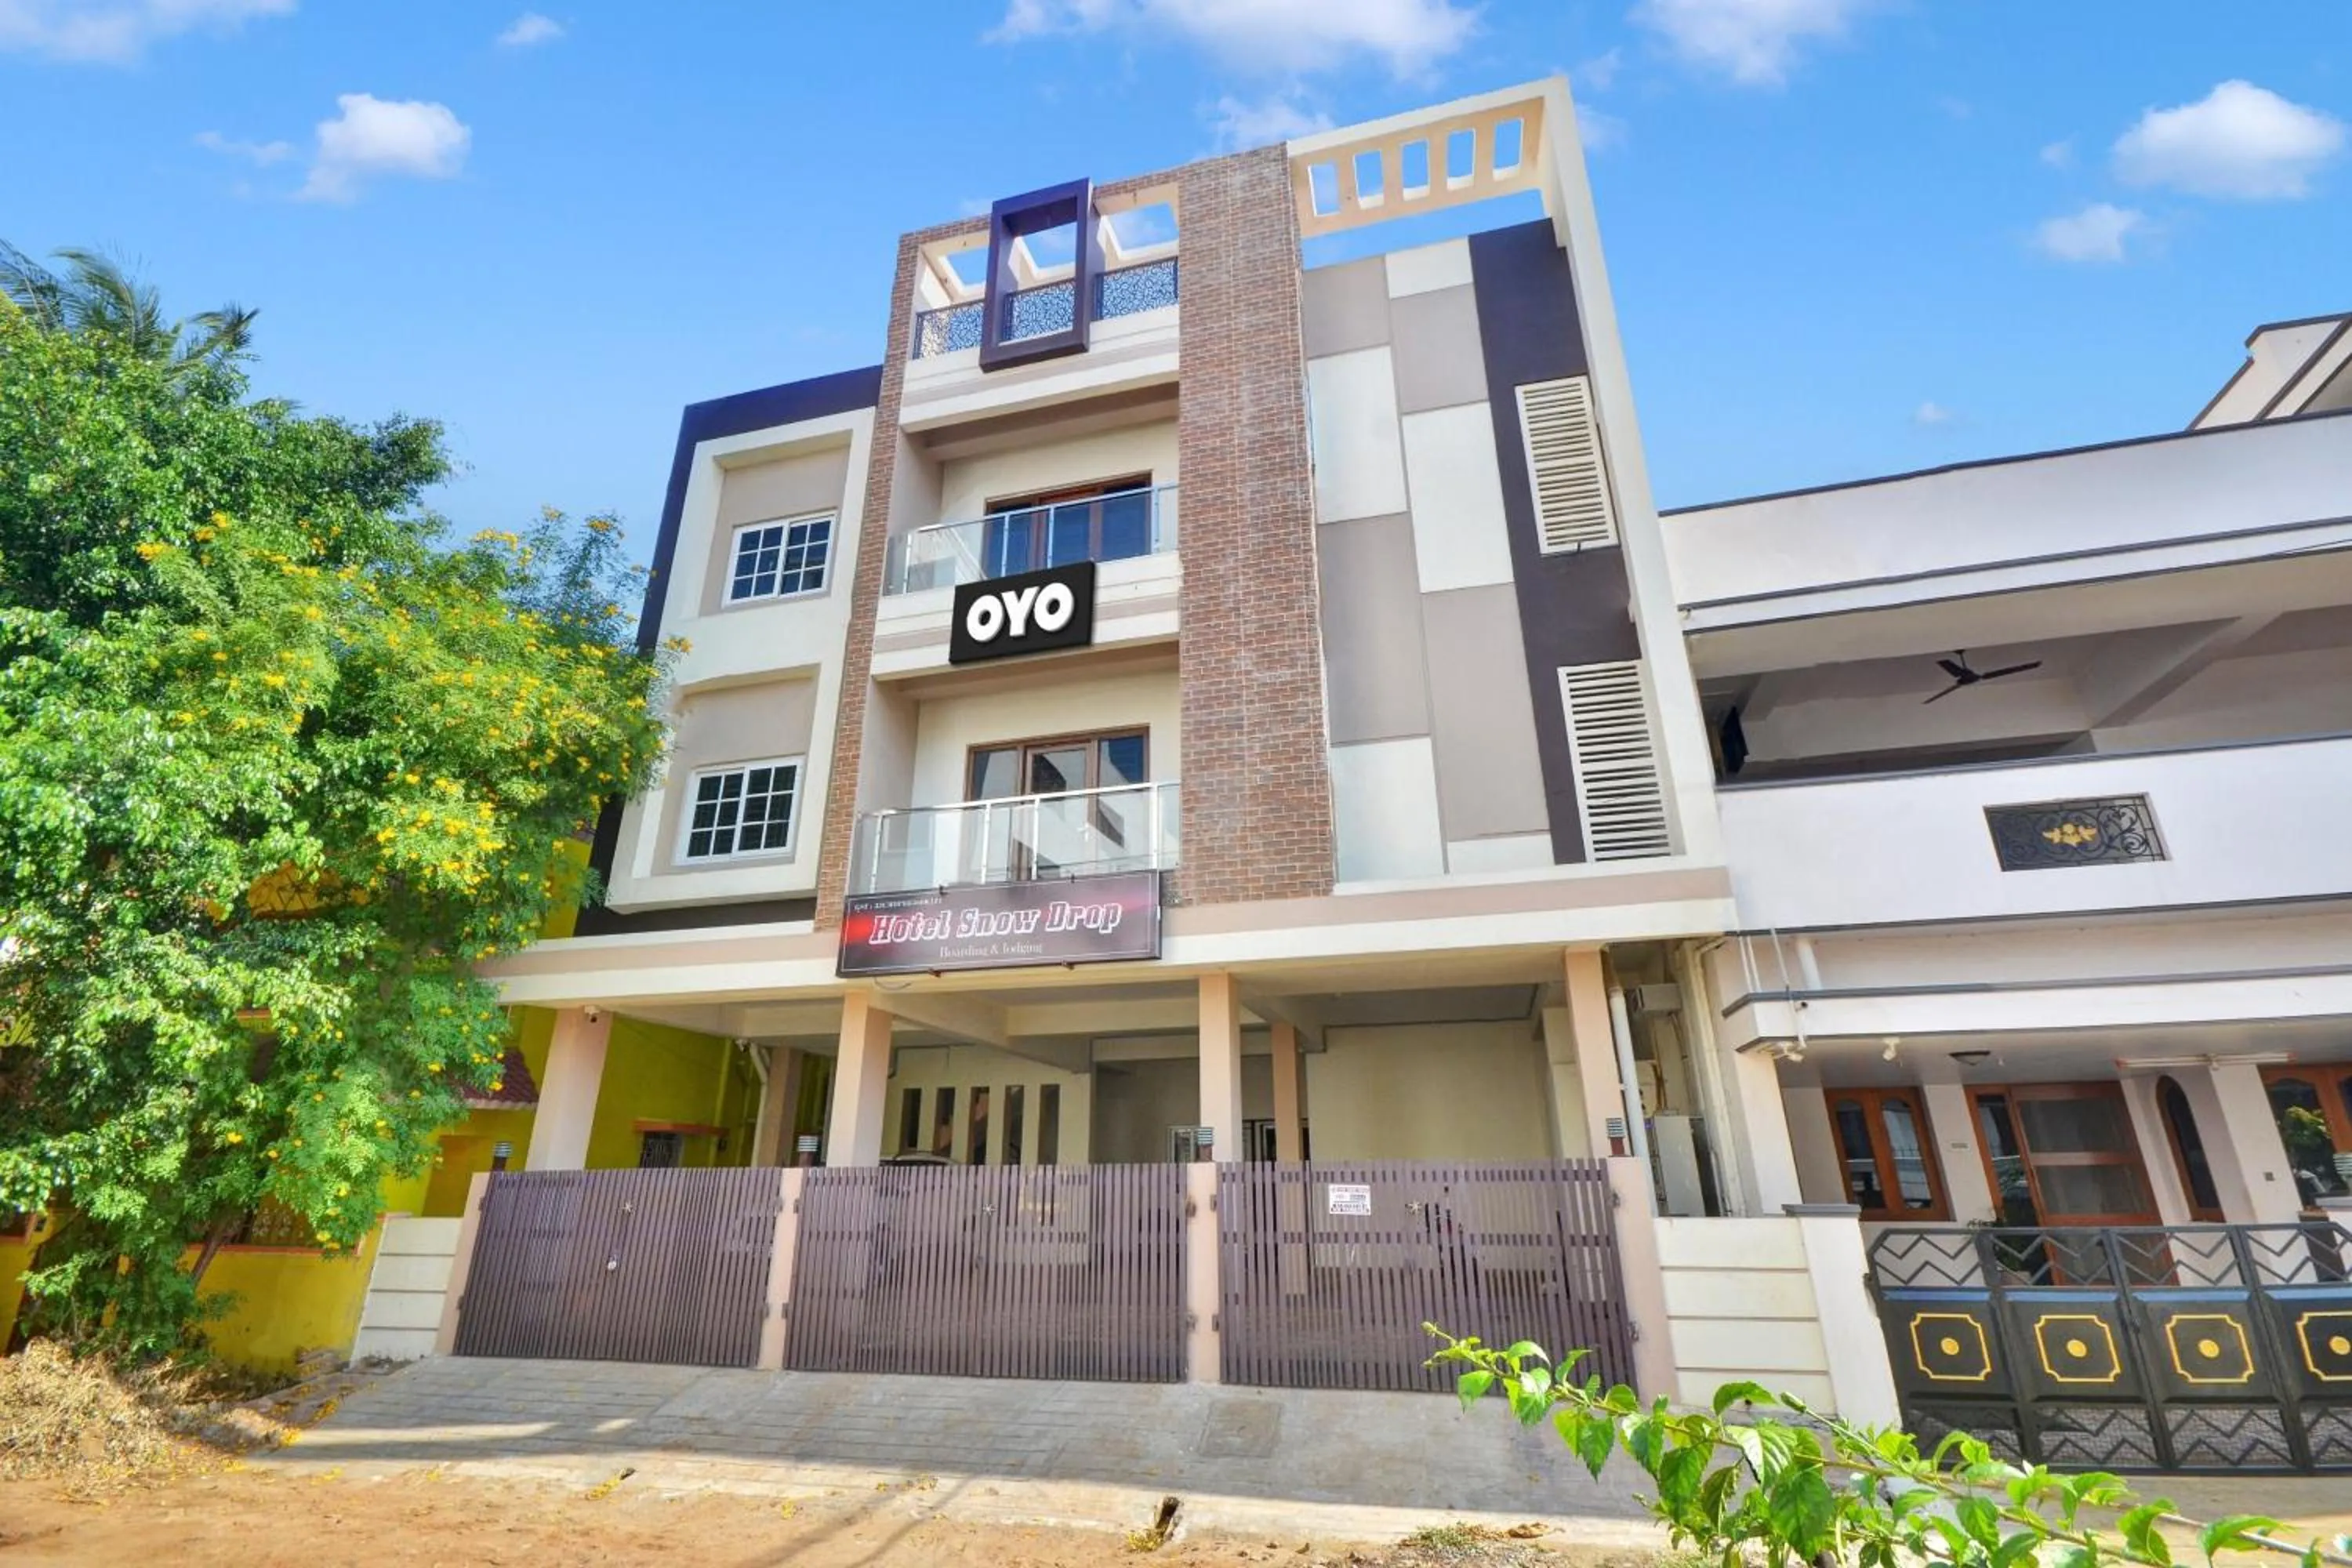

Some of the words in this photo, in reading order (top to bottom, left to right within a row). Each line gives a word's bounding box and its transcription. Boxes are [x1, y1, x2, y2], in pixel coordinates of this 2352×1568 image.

[967, 583, 1073, 642] OYO
[869, 909, 952, 945] Hotel
[956, 907, 1041, 938] Snow
[1045, 902, 1122, 935] Drop
[990, 943, 999, 954] &
